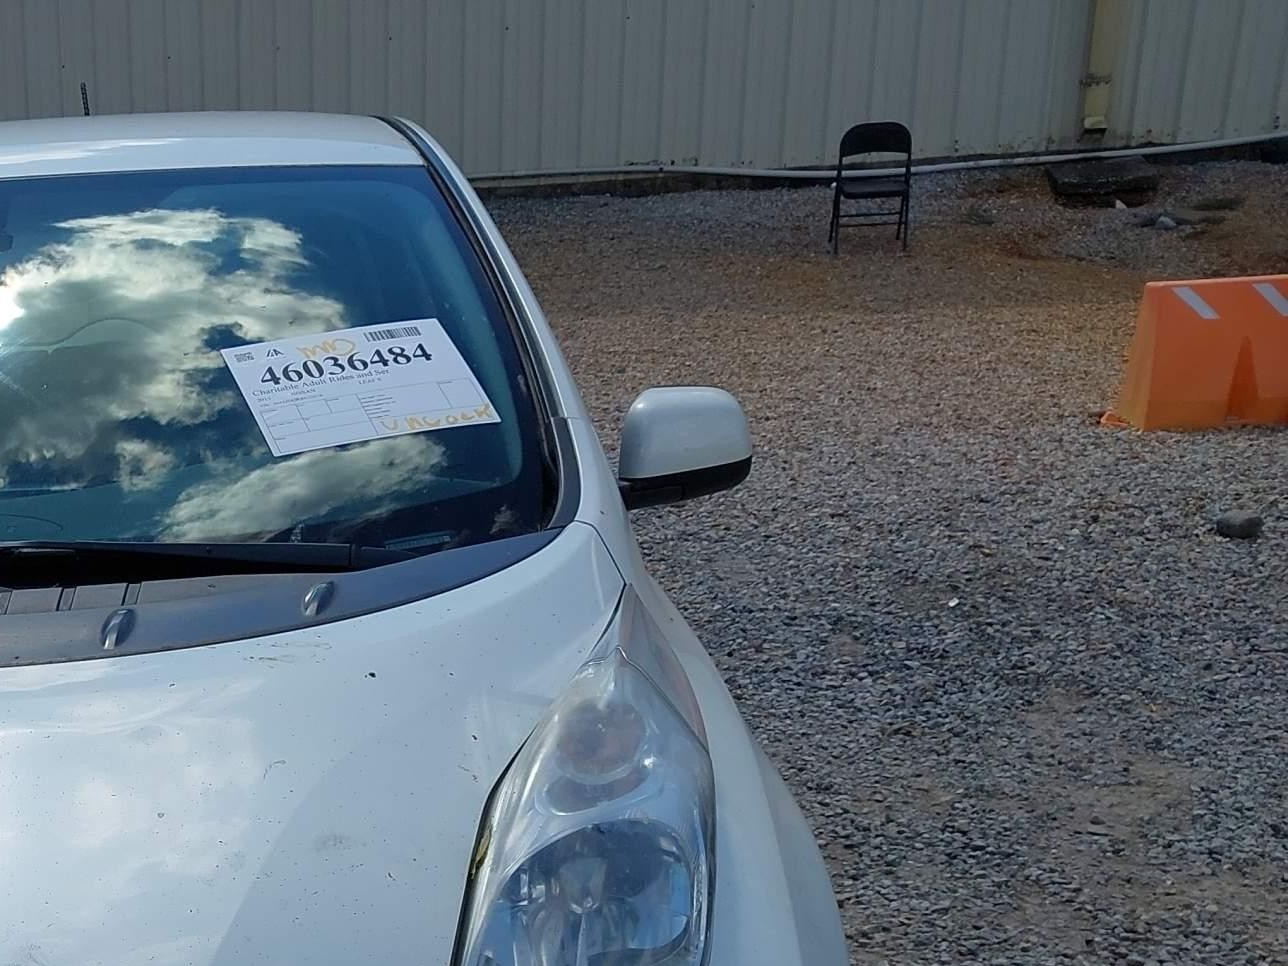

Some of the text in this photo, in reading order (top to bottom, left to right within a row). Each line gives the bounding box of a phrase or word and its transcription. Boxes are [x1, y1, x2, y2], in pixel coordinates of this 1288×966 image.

[252, 368, 390, 397] Charitable Adult Rides and Ser
[260, 343, 433, 386] 46036484
